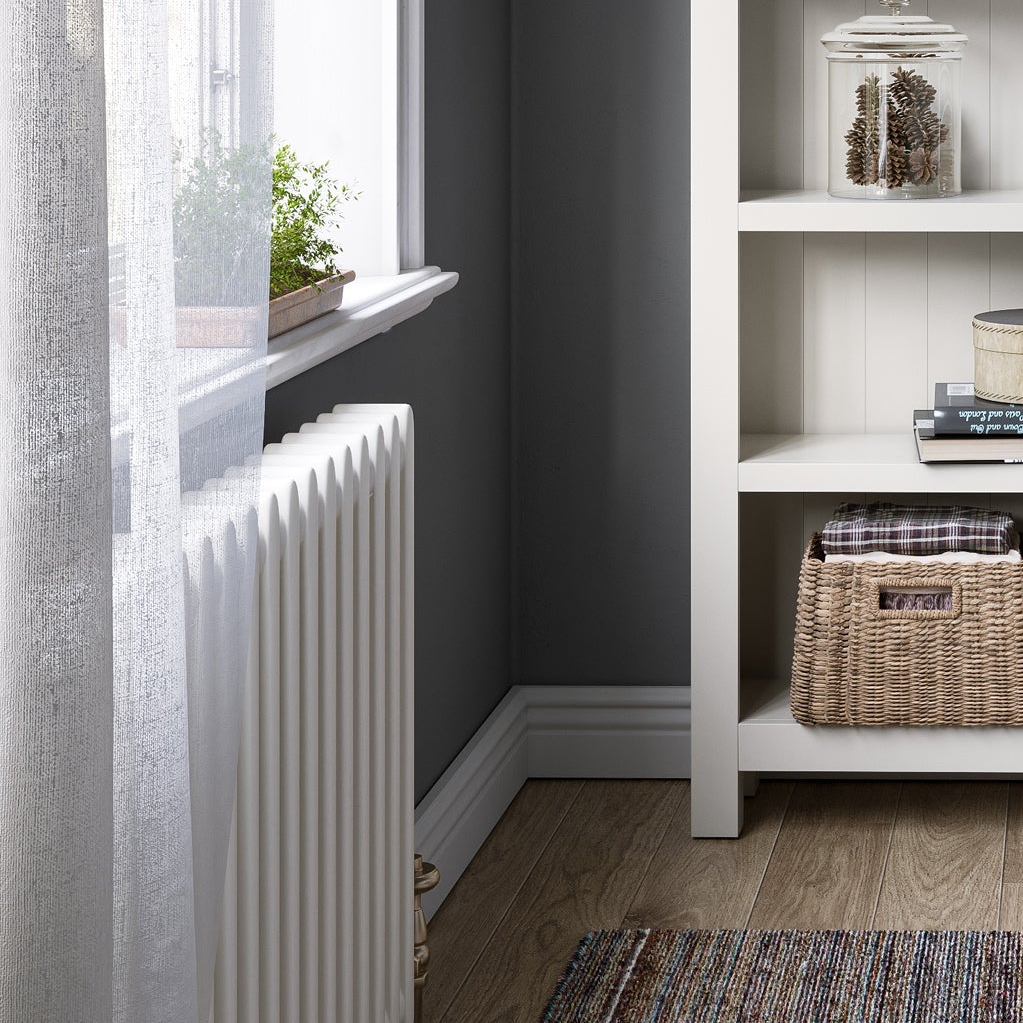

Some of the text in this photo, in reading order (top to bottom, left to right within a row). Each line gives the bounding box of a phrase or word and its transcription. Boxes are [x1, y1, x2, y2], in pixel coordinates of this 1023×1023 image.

[958, 410, 986, 421] London
[988, 410, 1003, 420] and
[970, 423, 984, 434] Out
[987, 423, 1001, 433] and
